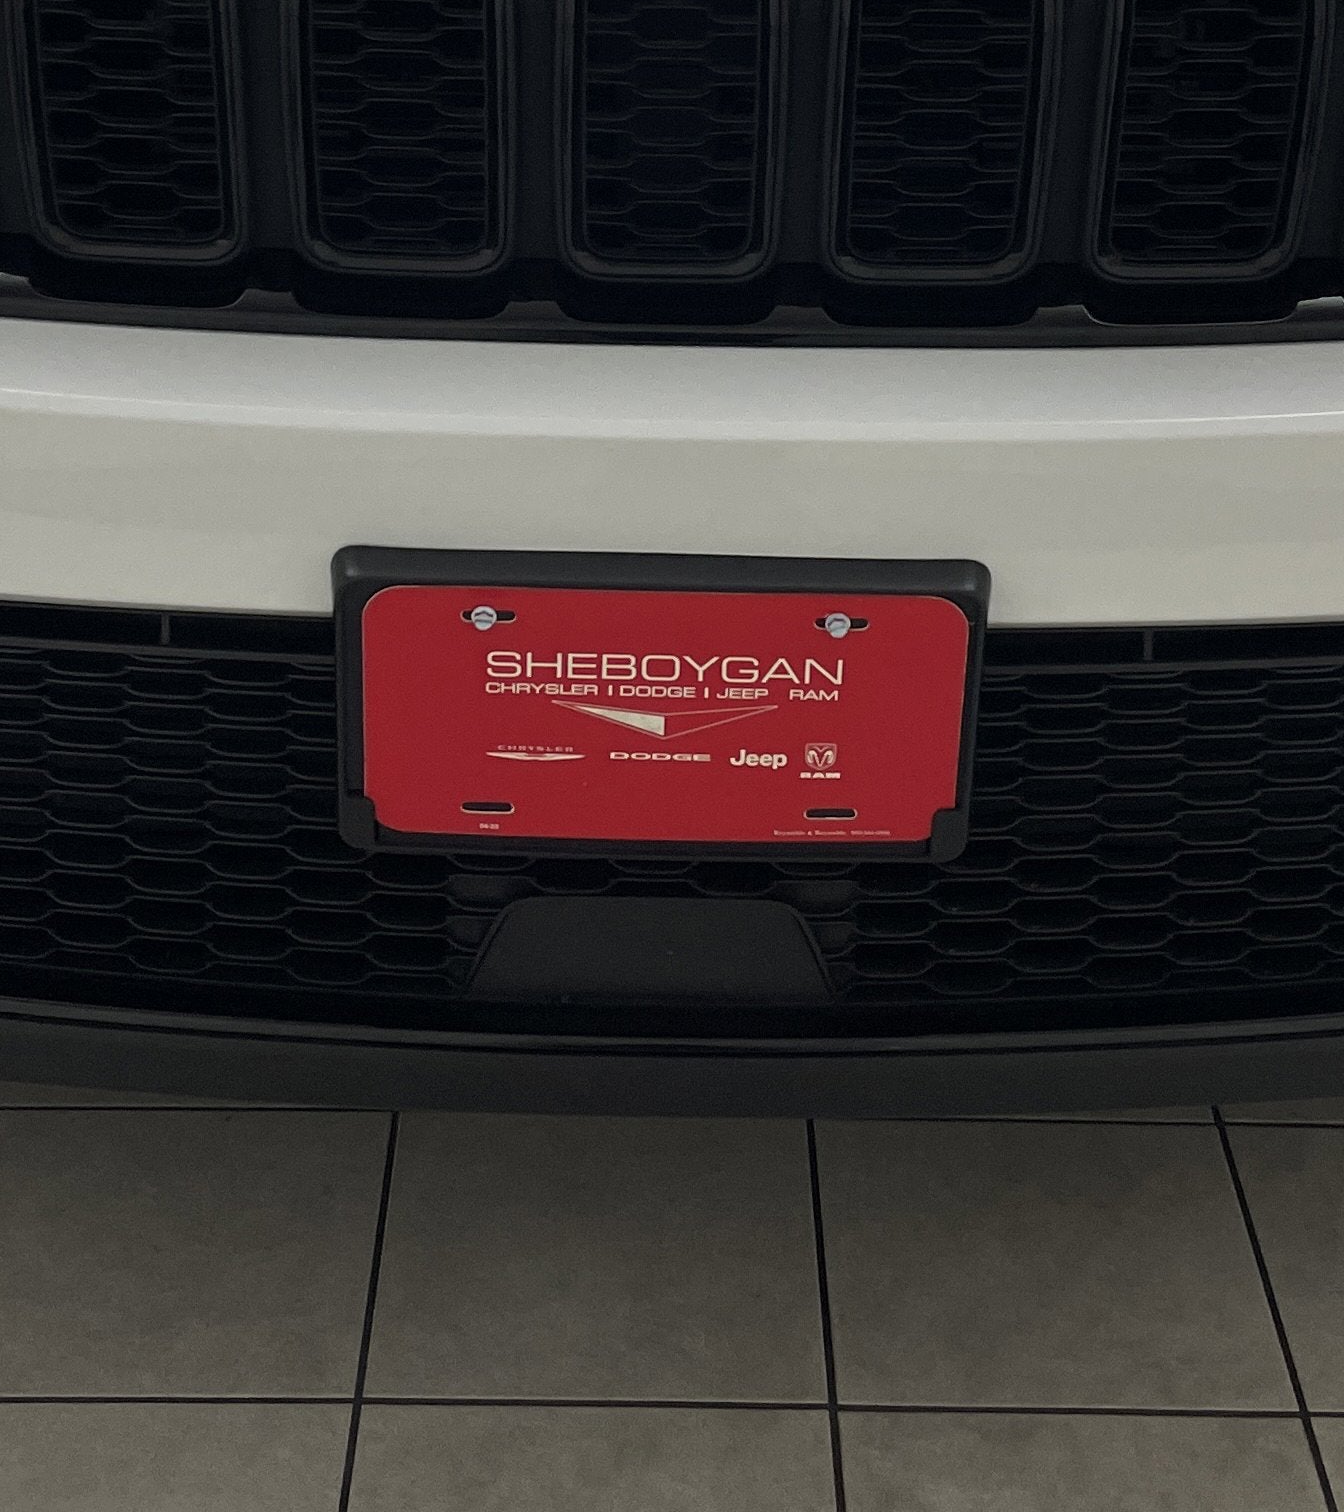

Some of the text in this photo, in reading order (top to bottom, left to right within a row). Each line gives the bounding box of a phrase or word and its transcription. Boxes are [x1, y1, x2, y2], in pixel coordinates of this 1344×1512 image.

[486, 650, 844, 686] SHEBOYGAN
[485, 681, 599, 696] CHRYSLER
[619, 685, 697, 698] DODGE
[716, 687, 769, 700] JEEP
[789, 689, 839, 702] RAM
[496, 744, 575, 753] CHRYSLER
[609, 751, 712, 763] DODGE
[729, 748, 788, 770] Jeep
[799, 771, 842, 780] RAM
